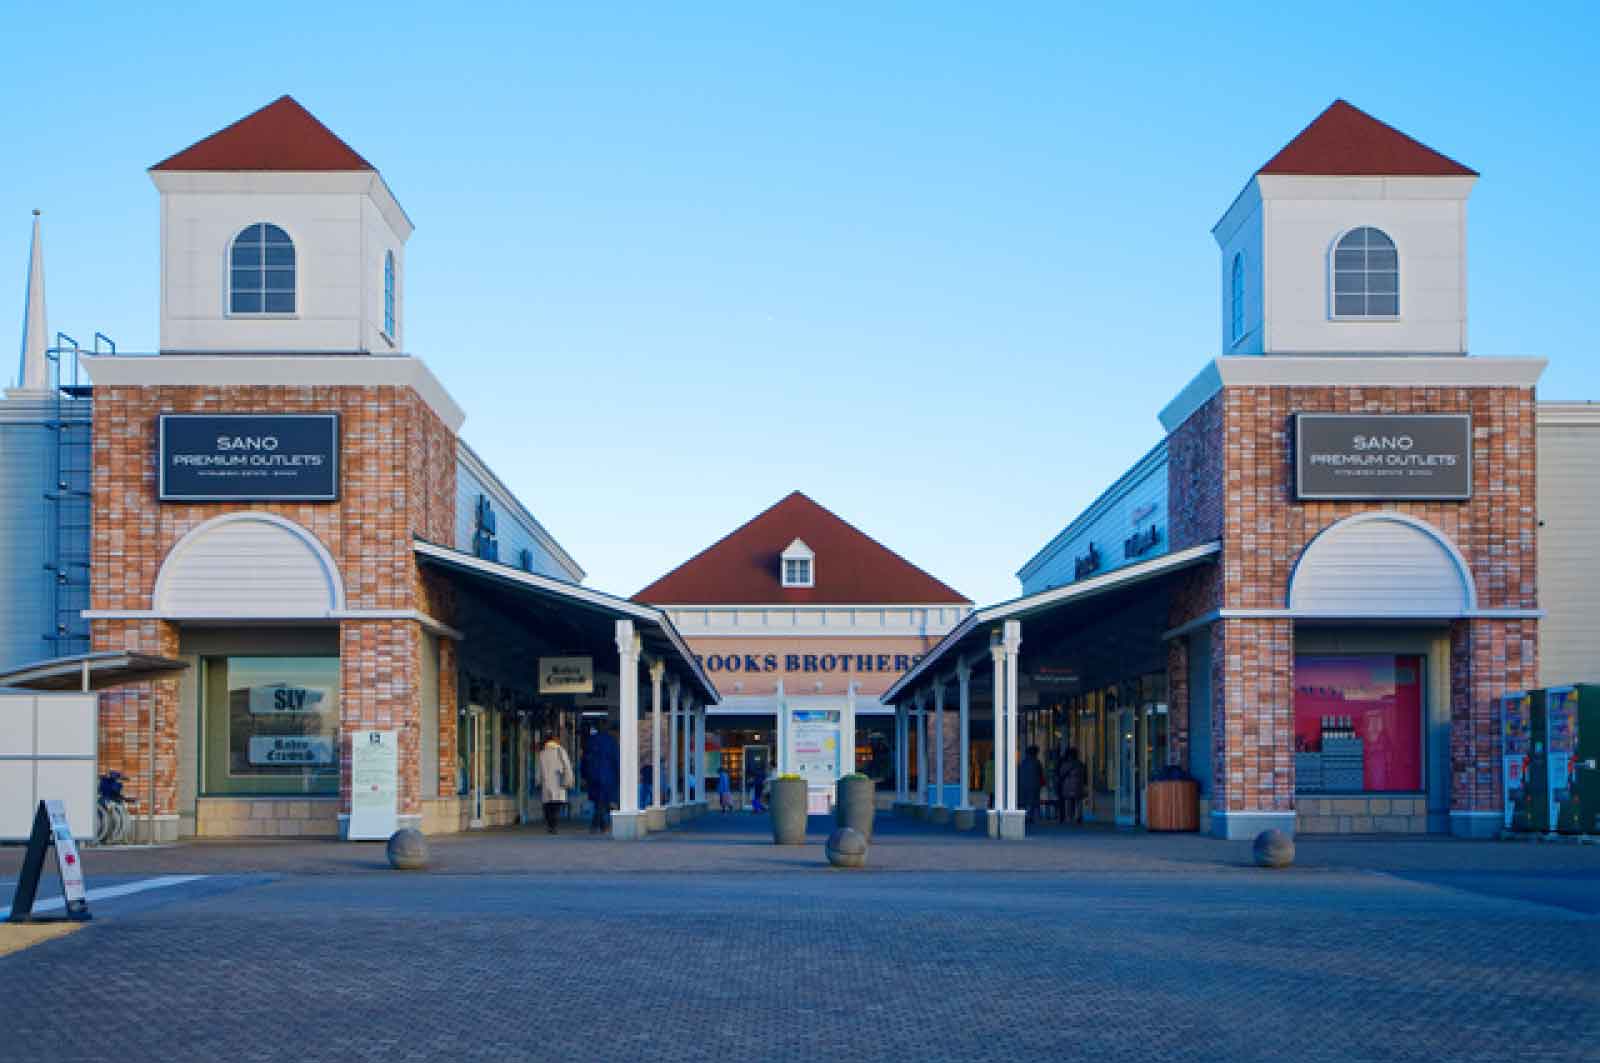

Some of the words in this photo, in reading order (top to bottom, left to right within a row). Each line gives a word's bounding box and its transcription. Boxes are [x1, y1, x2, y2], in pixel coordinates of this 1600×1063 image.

[216, 436, 279, 451] SANO
[1353, 435, 1414, 451] SANO
[173, 454, 247, 466] PREMIUM
[250, 454, 322, 466] OUTLETS
[1310, 454, 1384, 466] PREMIUM
[1387, 454, 1457, 466] OUTLETS
